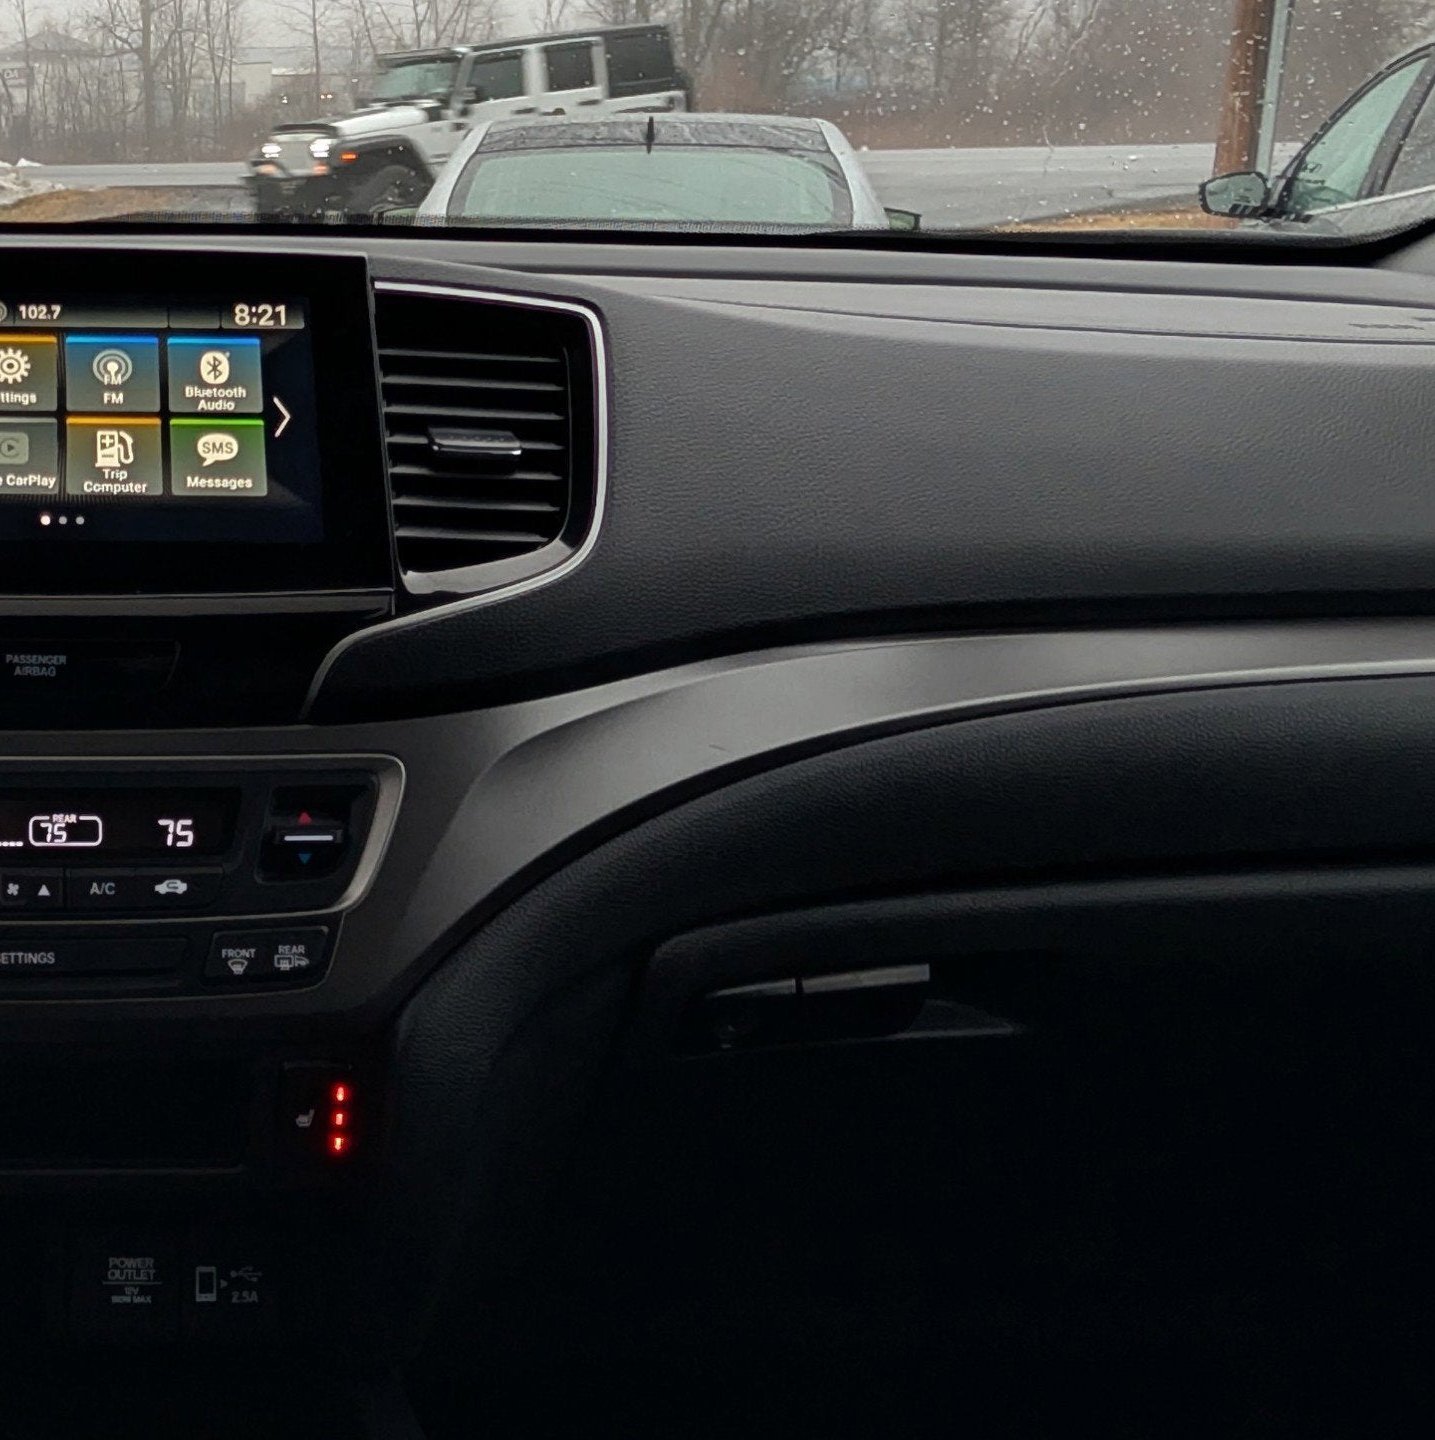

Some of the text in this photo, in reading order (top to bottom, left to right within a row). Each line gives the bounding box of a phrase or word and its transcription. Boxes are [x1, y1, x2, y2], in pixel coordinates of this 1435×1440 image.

[19, 304, 62, 320] 102.7
[233, 303, 287, 327] 8:21
[184, 385, 247, 398] Bluetooth
[103, 392, 124, 405] FM
[197, 399, 235, 411] Audio
[201, 441, 234, 455] SMS
[102, 468, 128, 481] Trip
[6, 474, 57, 489] CarPlay
[83, 480, 148, 494] Computer
[186, 476, 253, 491] Messages
[5, 653, 67, 665] PASSENGER
[14, 666, 56, 678] AIRBAG
[51, 813, 78, 824] REAR
[39, 822, 68, 844] 75
[157, 818, 194, 847] 75
[89, 882, 116, 896] A/C
[221, 947, 257, 959] FRONT
[277, 944, 305, 955] REAR
[108, 1257, 154, 1269] POWER
[107, 1269, 156, 1281] OUTLET
[230, 1290, 259, 1304] 2.5A
